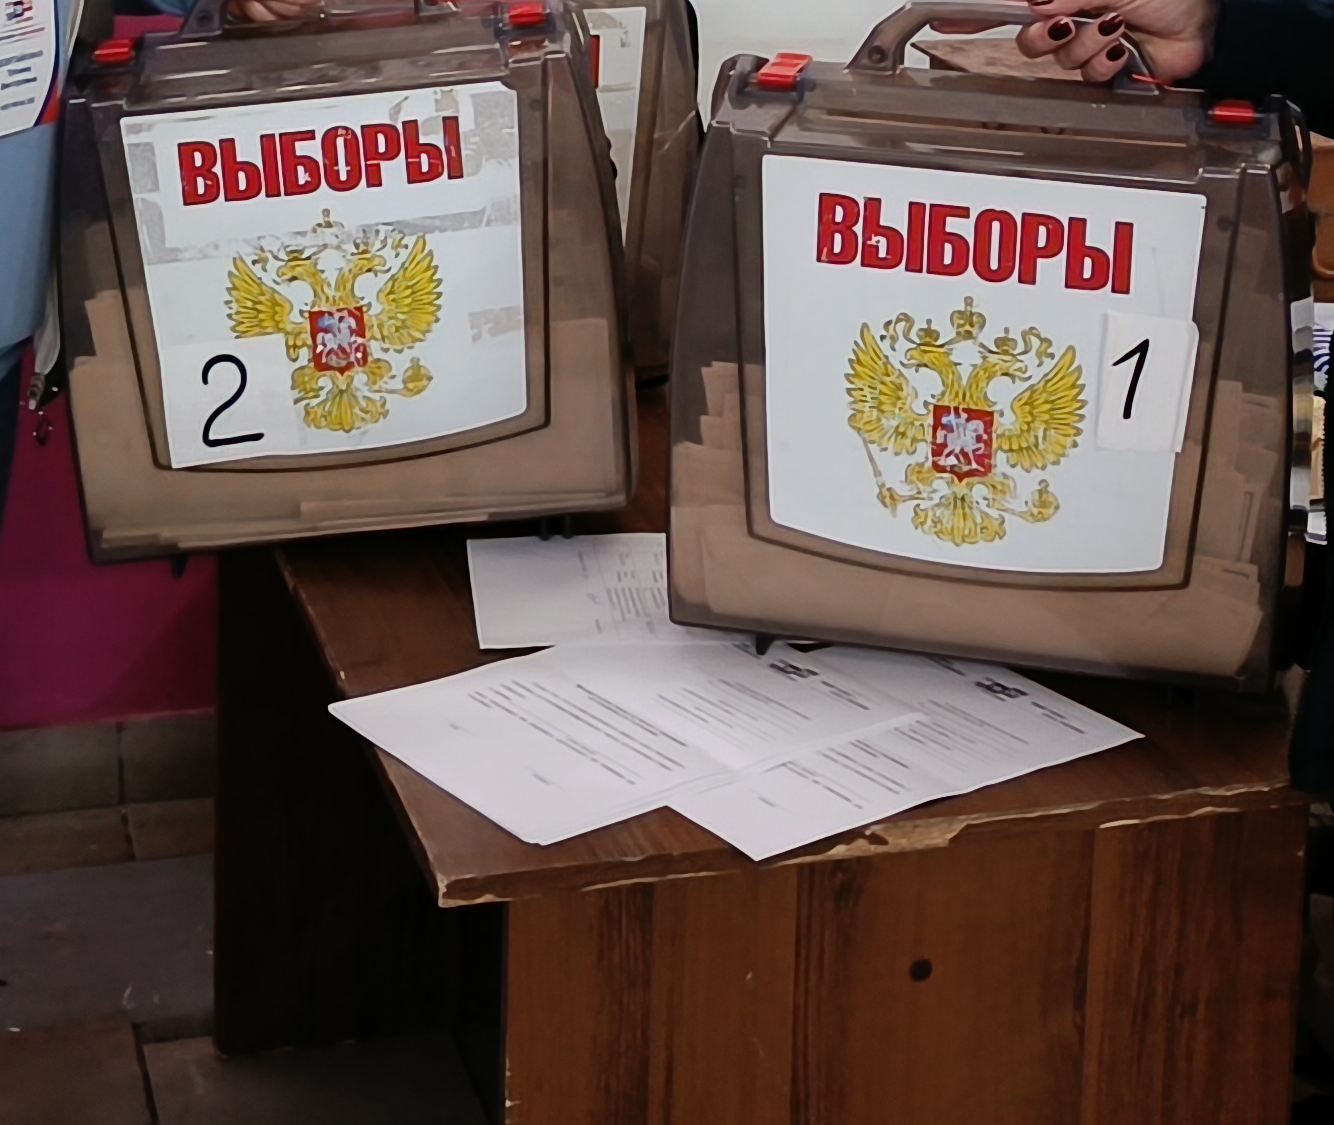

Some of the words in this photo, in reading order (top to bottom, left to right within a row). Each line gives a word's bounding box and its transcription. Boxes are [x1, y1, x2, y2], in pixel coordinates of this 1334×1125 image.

[177, 115, 465, 207] ВЫБОРЫ
[815, 192, 1135, 295] ВЫБОРЫ
[200, 353, 266, 449] 2
[1111, 338, 1151, 421] 1
